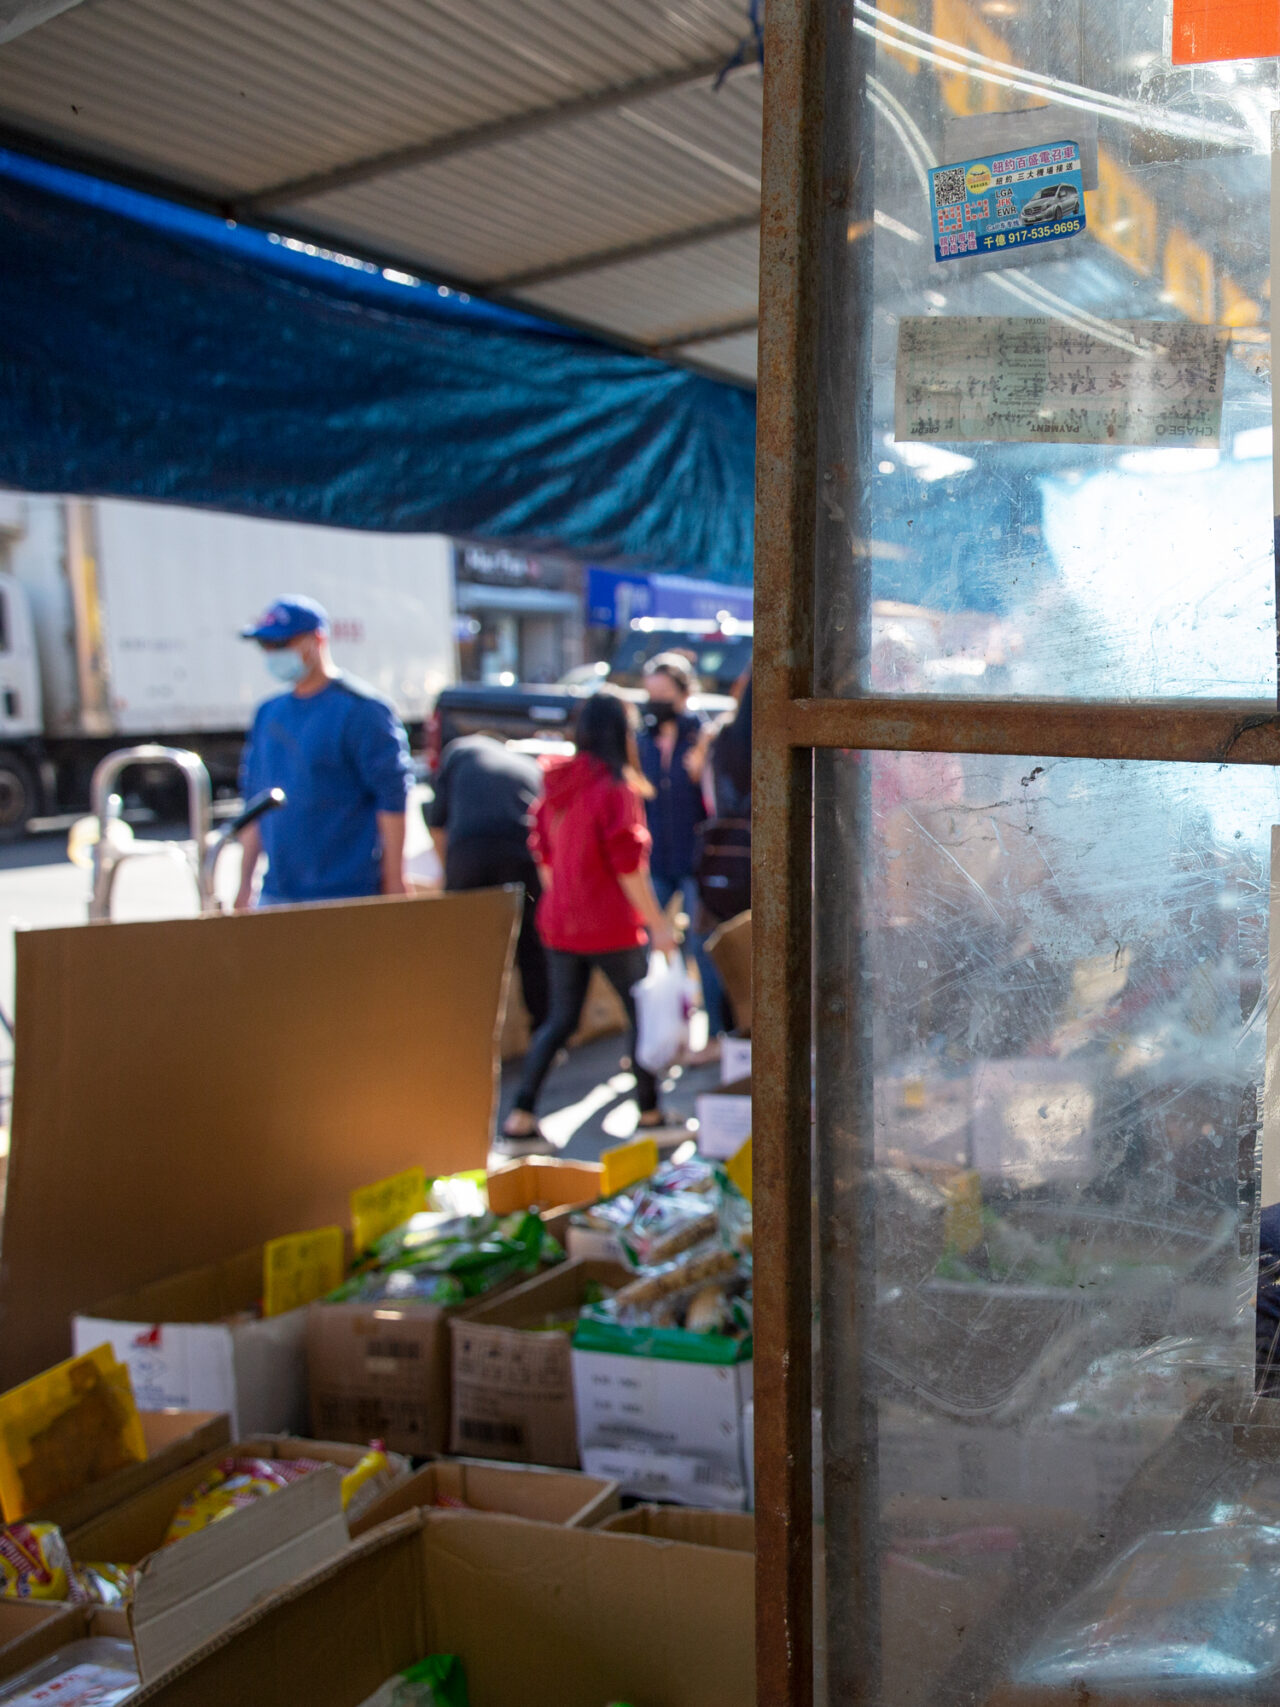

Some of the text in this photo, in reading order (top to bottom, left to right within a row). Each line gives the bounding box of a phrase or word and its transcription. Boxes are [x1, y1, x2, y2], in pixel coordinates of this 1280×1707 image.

[995, 187, 1014, 198] LGA
[995, 198, 1012, 209] JFK
[997, 206, 1017, 217] EWR
[1008, 219, 1080, 244] 917-535-9695
[1030, 423, 1080, 434] PAYMENT
[1169, 424, 1214, 438] CHASE
